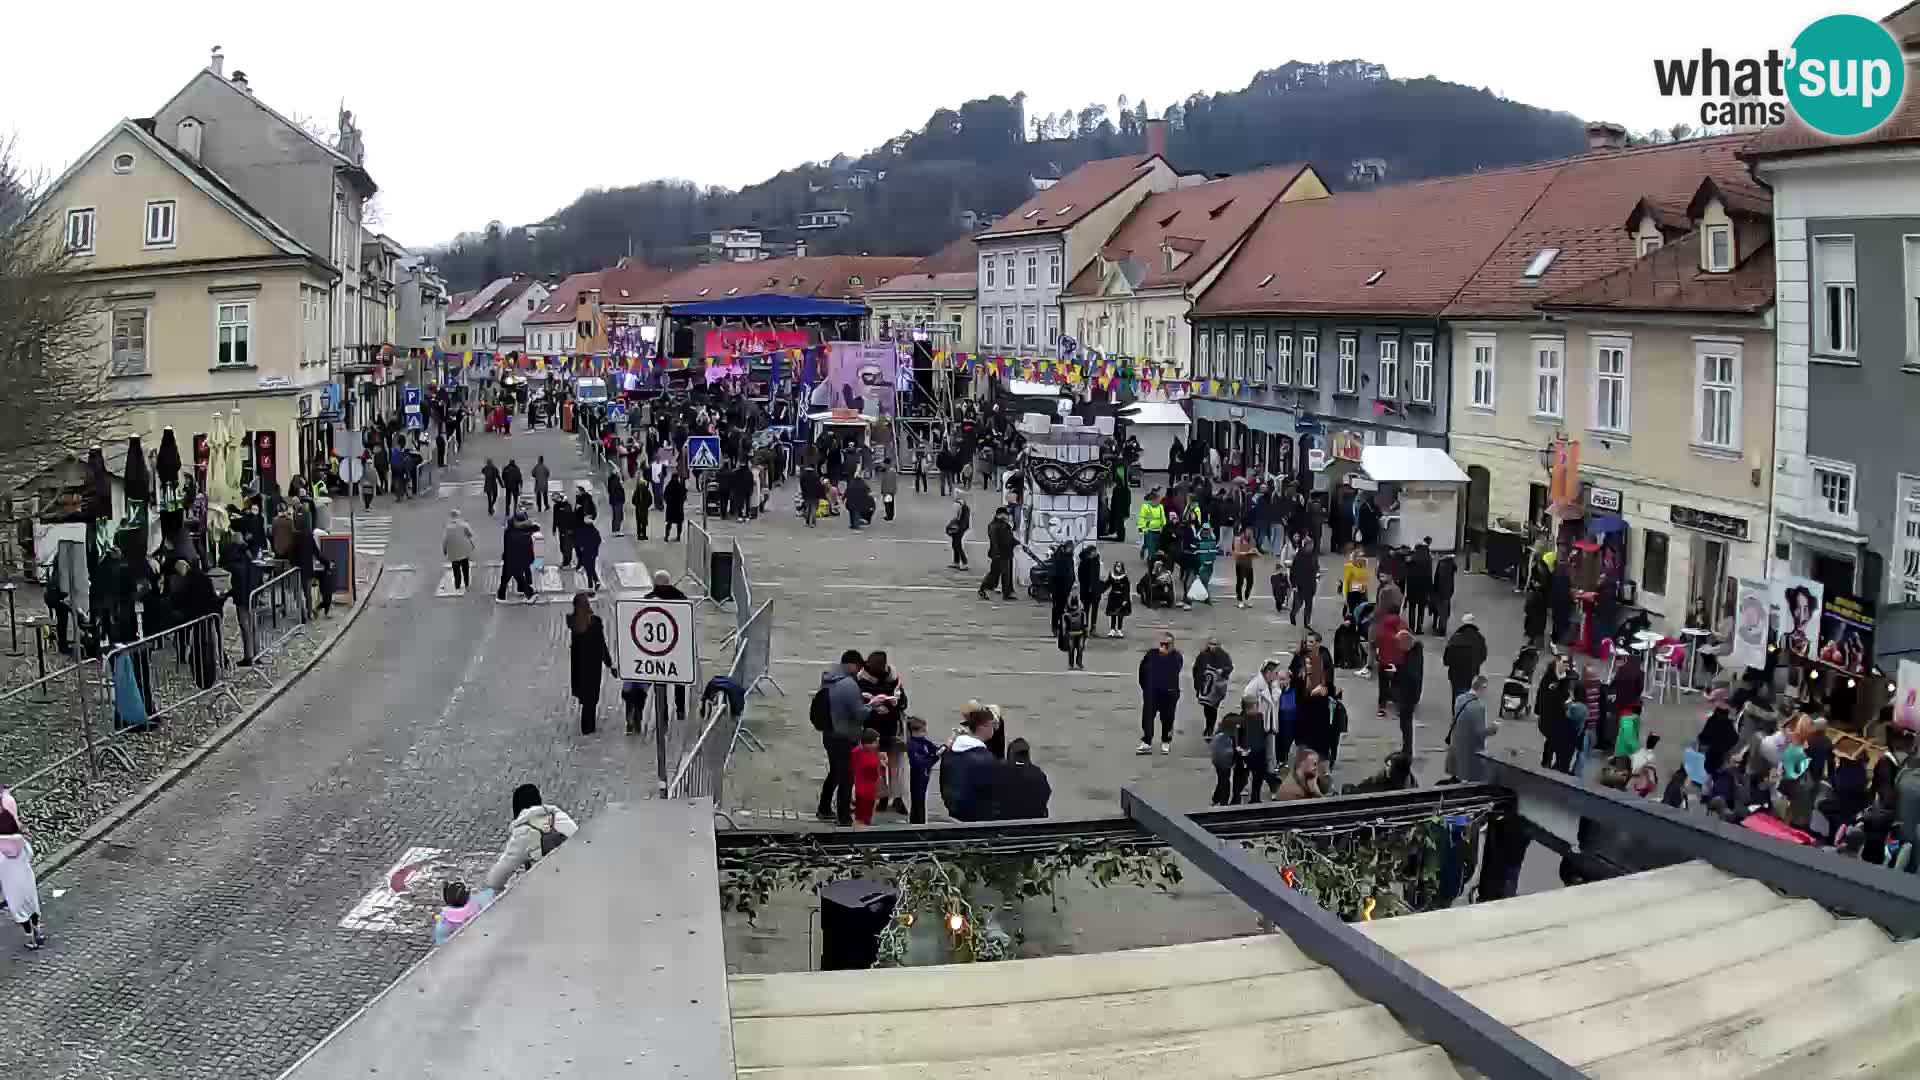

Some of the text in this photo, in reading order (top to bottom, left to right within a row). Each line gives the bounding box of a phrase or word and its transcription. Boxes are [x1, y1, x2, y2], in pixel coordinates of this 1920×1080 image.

[407, 391, 416, 403] P
[643, 622, 668, 643] 30
[633, 659, 679, 677] ZONA
